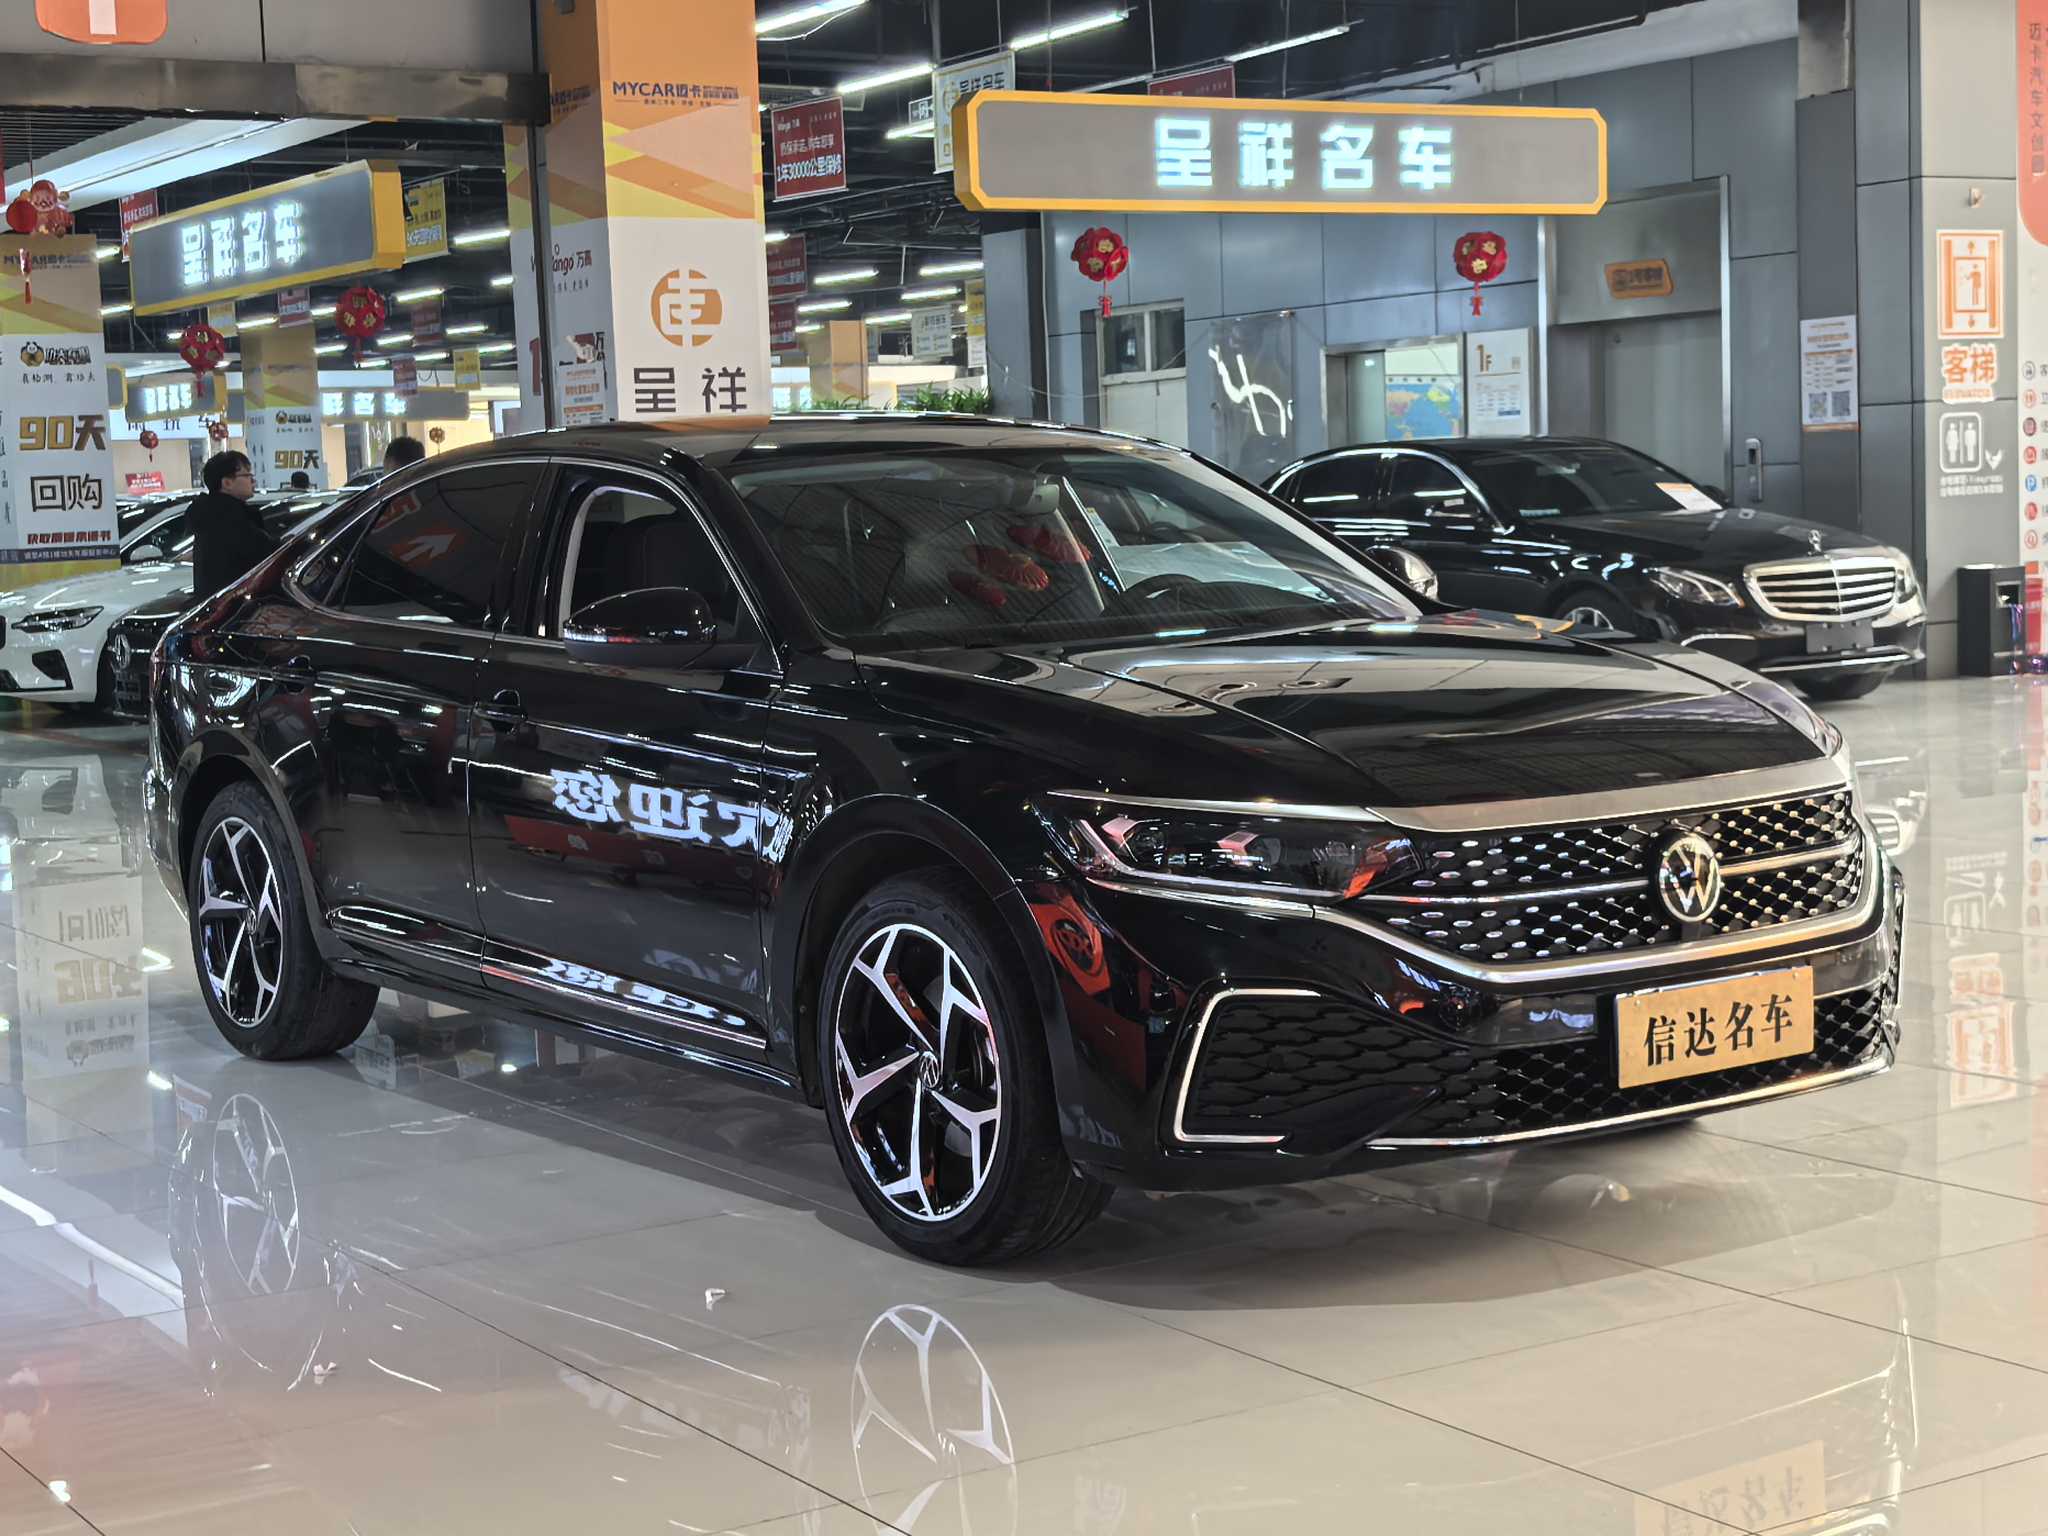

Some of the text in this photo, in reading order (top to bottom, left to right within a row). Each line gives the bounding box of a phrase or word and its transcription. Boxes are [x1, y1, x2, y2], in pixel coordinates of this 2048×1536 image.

[1153, 116, 1455, 192] 呈祥名车
[1943, 346, 1996, 384] 客梯
[633, 366, 747, 414] 呈祥
[19, 414, 107, 451] 90天
[274, 449, 320, 470] 90天
[30, 472, 103, 512] 回购
[1643, 993, 1793, 1067] 信达名车
